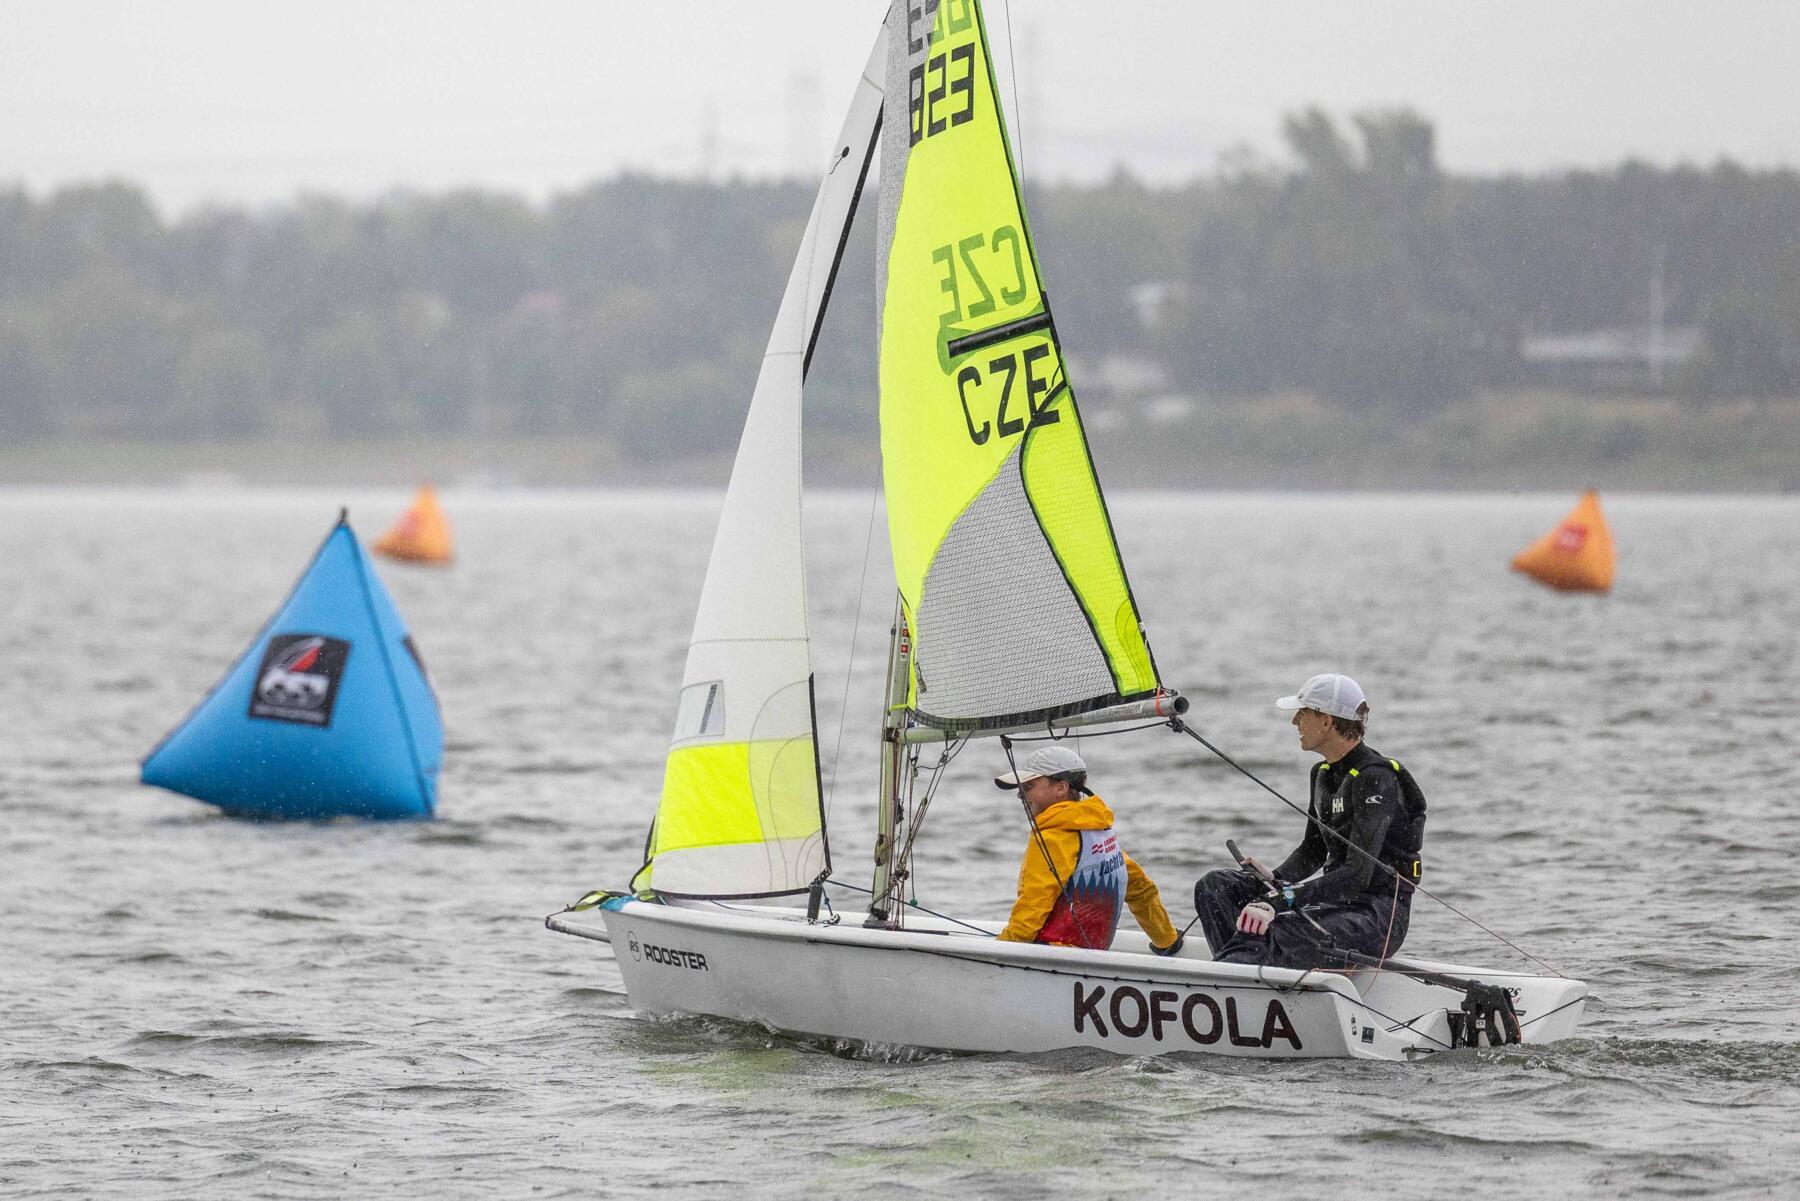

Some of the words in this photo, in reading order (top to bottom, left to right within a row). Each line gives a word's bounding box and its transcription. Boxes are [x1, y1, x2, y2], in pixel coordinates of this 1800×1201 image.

[908, 42, 976, 149] 823
[956, 342, 1061, 446] CZE
[1332, 797, 1344, 813] HH
[629, 940, 640, 953] RS
[643, 943, 709, 971] ROOSTER
[1073, 981, 1303, 1050] KOFOLA
